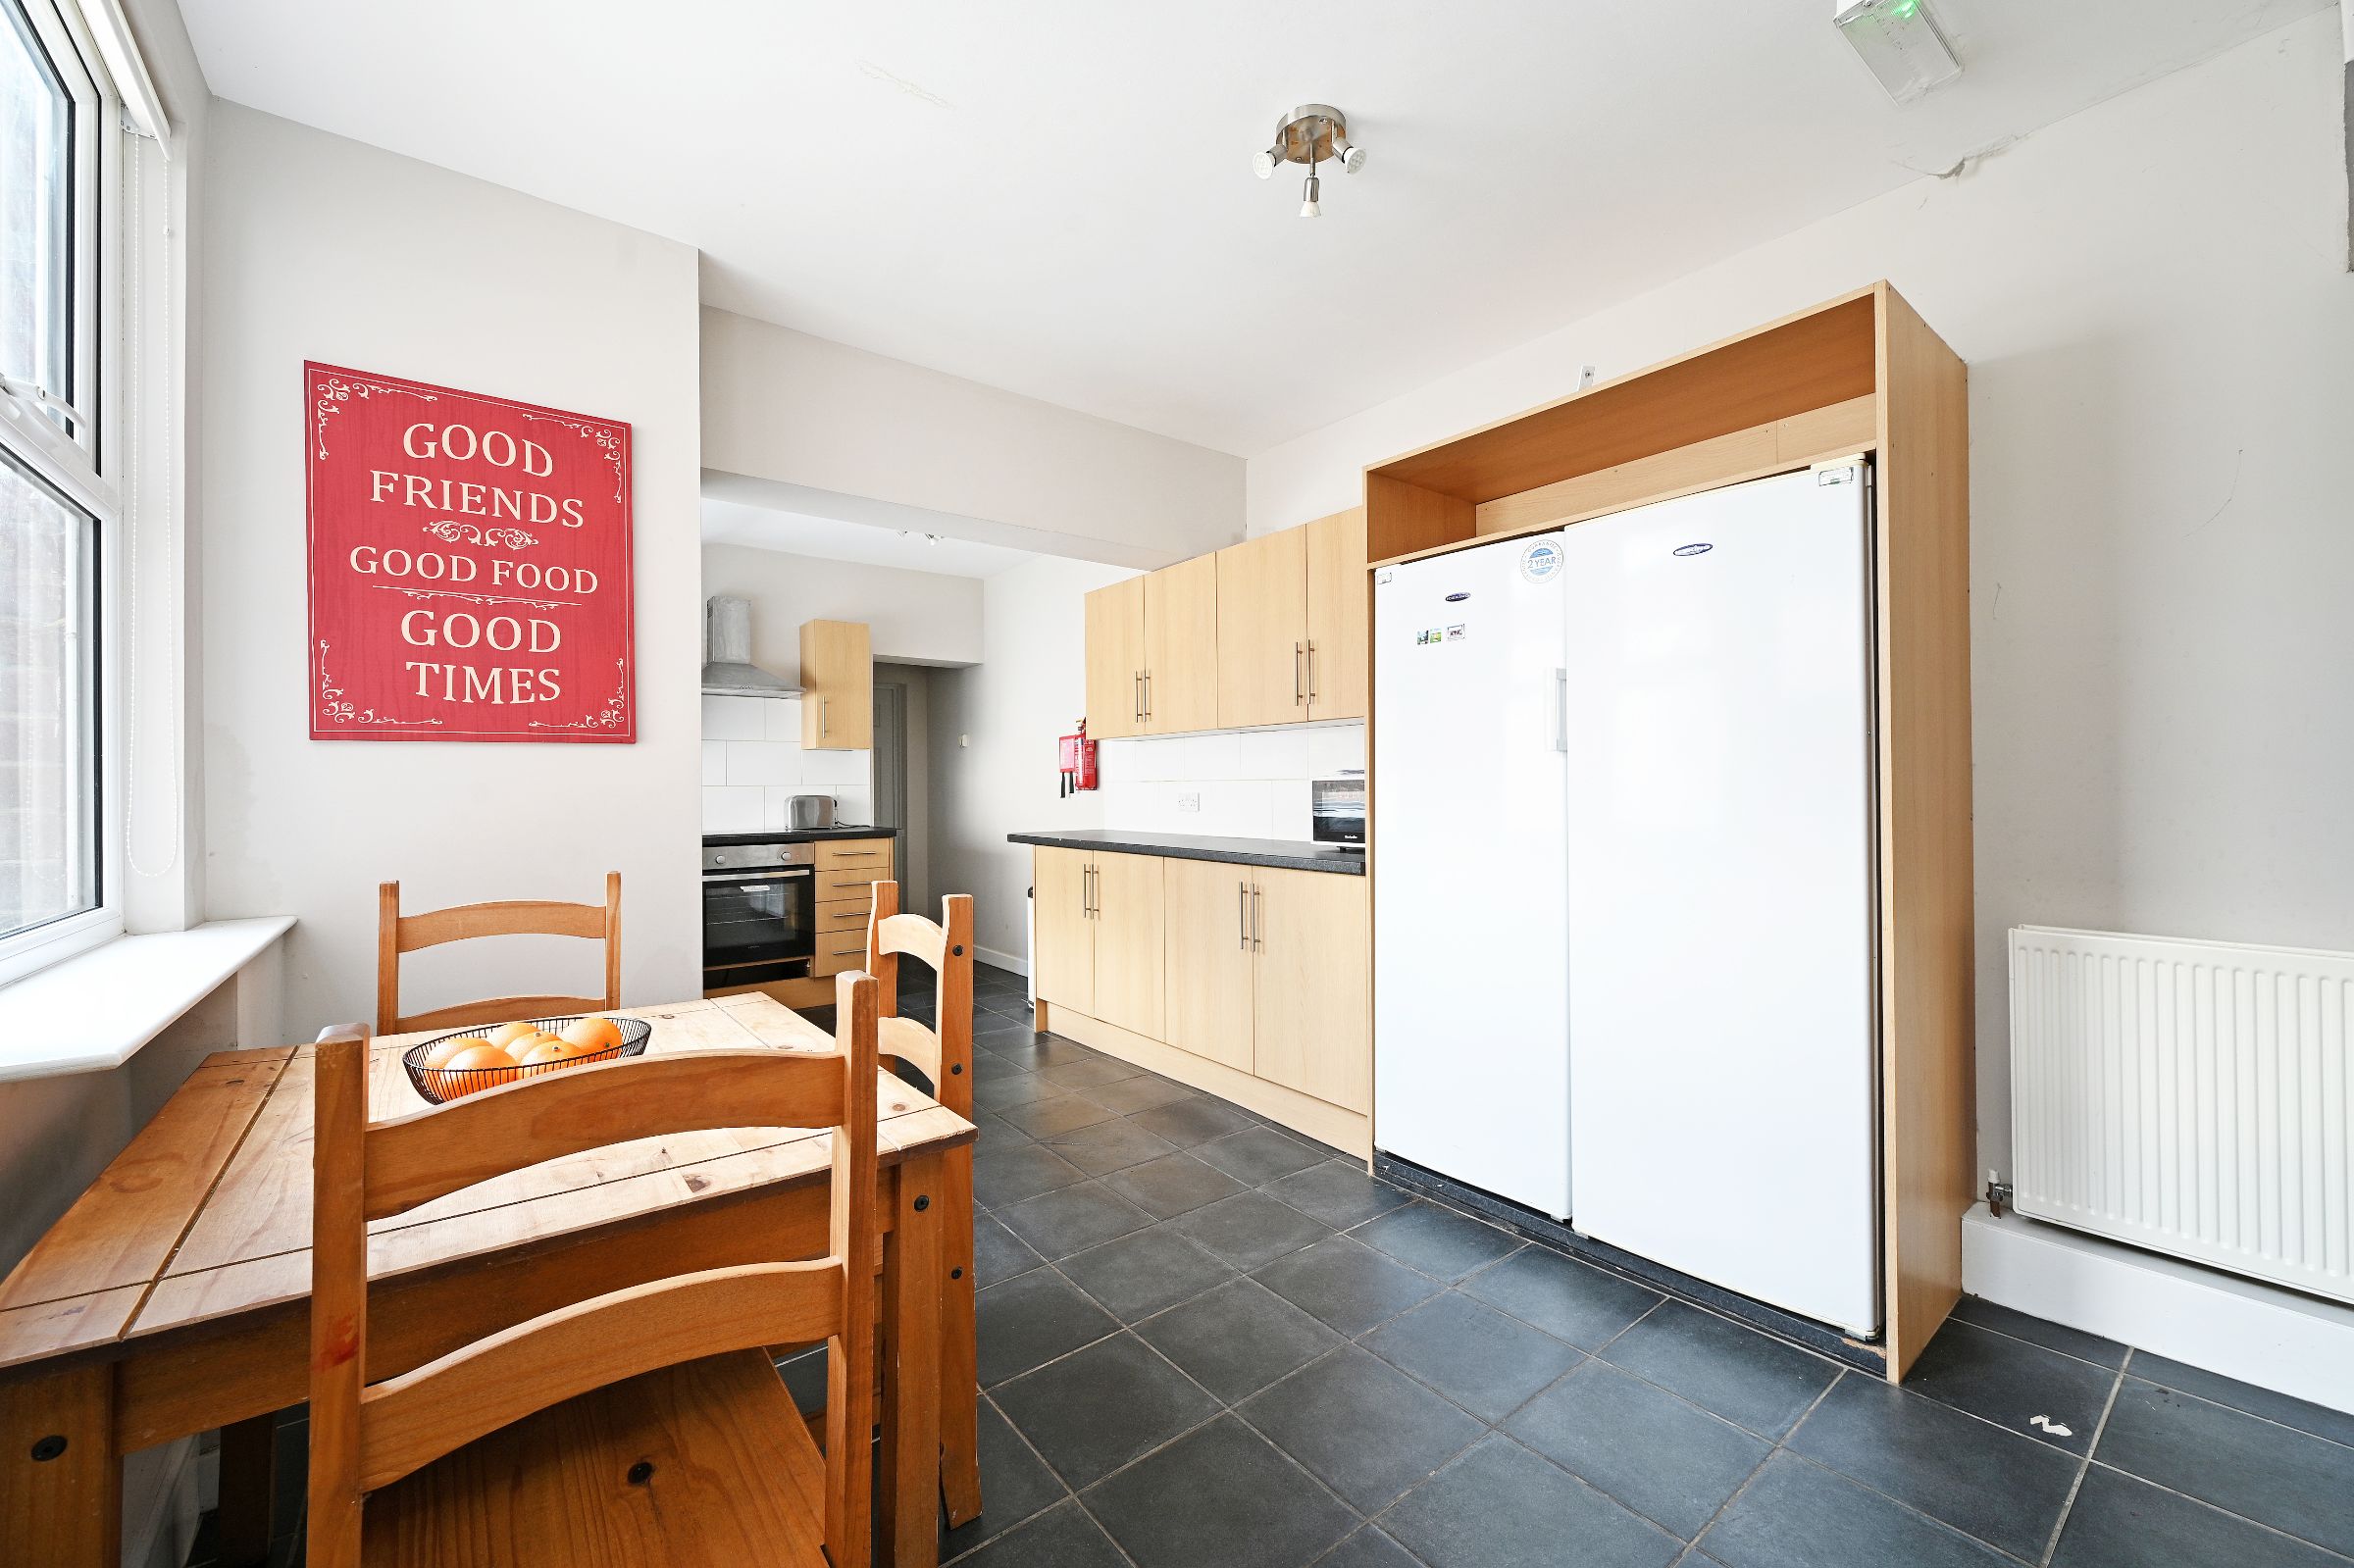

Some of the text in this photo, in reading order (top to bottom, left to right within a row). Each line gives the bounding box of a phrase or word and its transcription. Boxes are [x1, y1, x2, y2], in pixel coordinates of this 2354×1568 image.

[403, 423, 554, 479] GOOD
[370, 470, 584, 529] FRIENDS
[349, 545, 598, 594] GOOD FOOD
[1527, 556, 1557, 569] 2 YEAR
[400, 609, 561, 653] GOOD
[405, 661, 561, 705] TIMES
